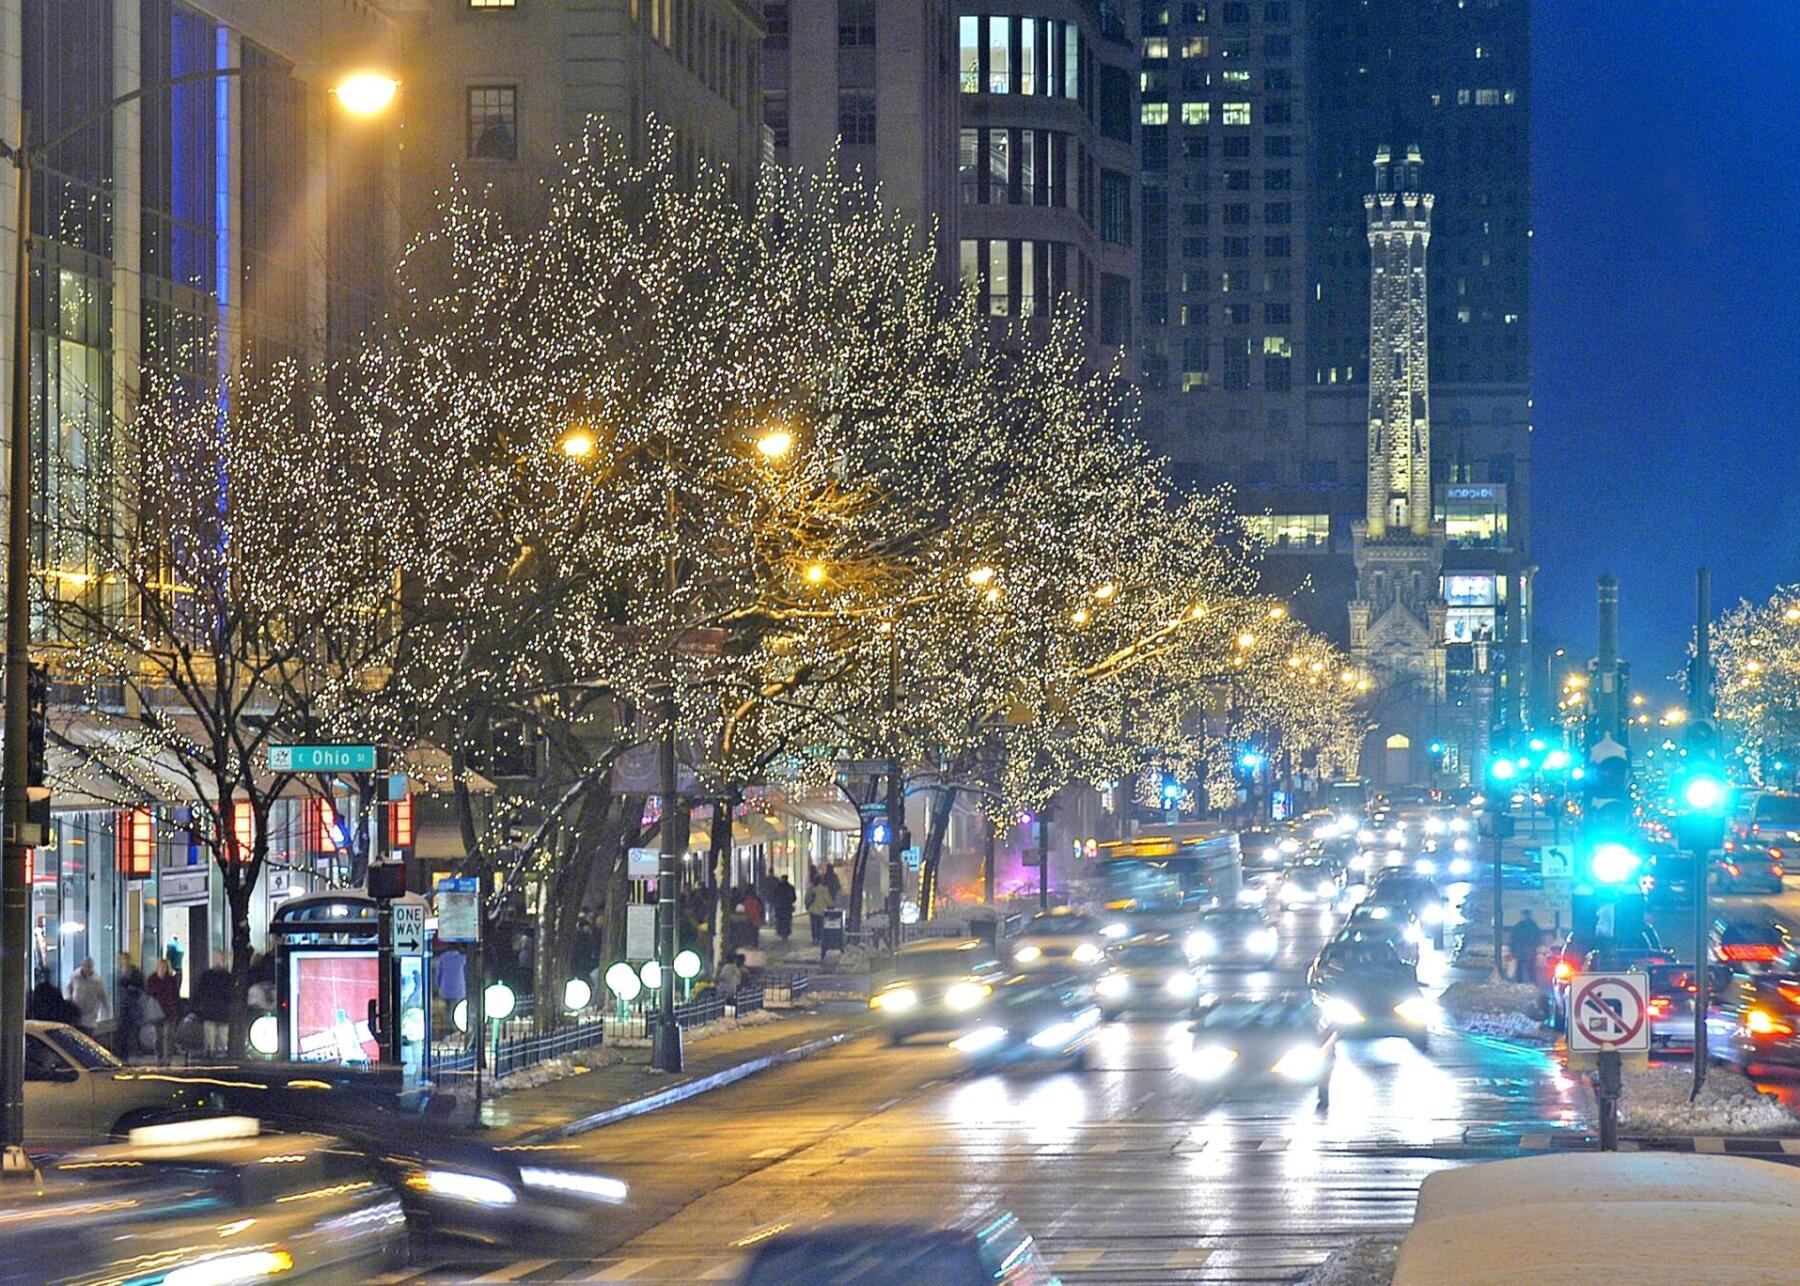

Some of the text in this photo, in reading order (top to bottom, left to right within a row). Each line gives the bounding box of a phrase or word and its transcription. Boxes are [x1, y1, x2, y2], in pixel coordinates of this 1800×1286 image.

[312, 750, 350, 766] Ohio
[397, 909, 420, 921] ONE
[396, 923, 421, 935] WAY
